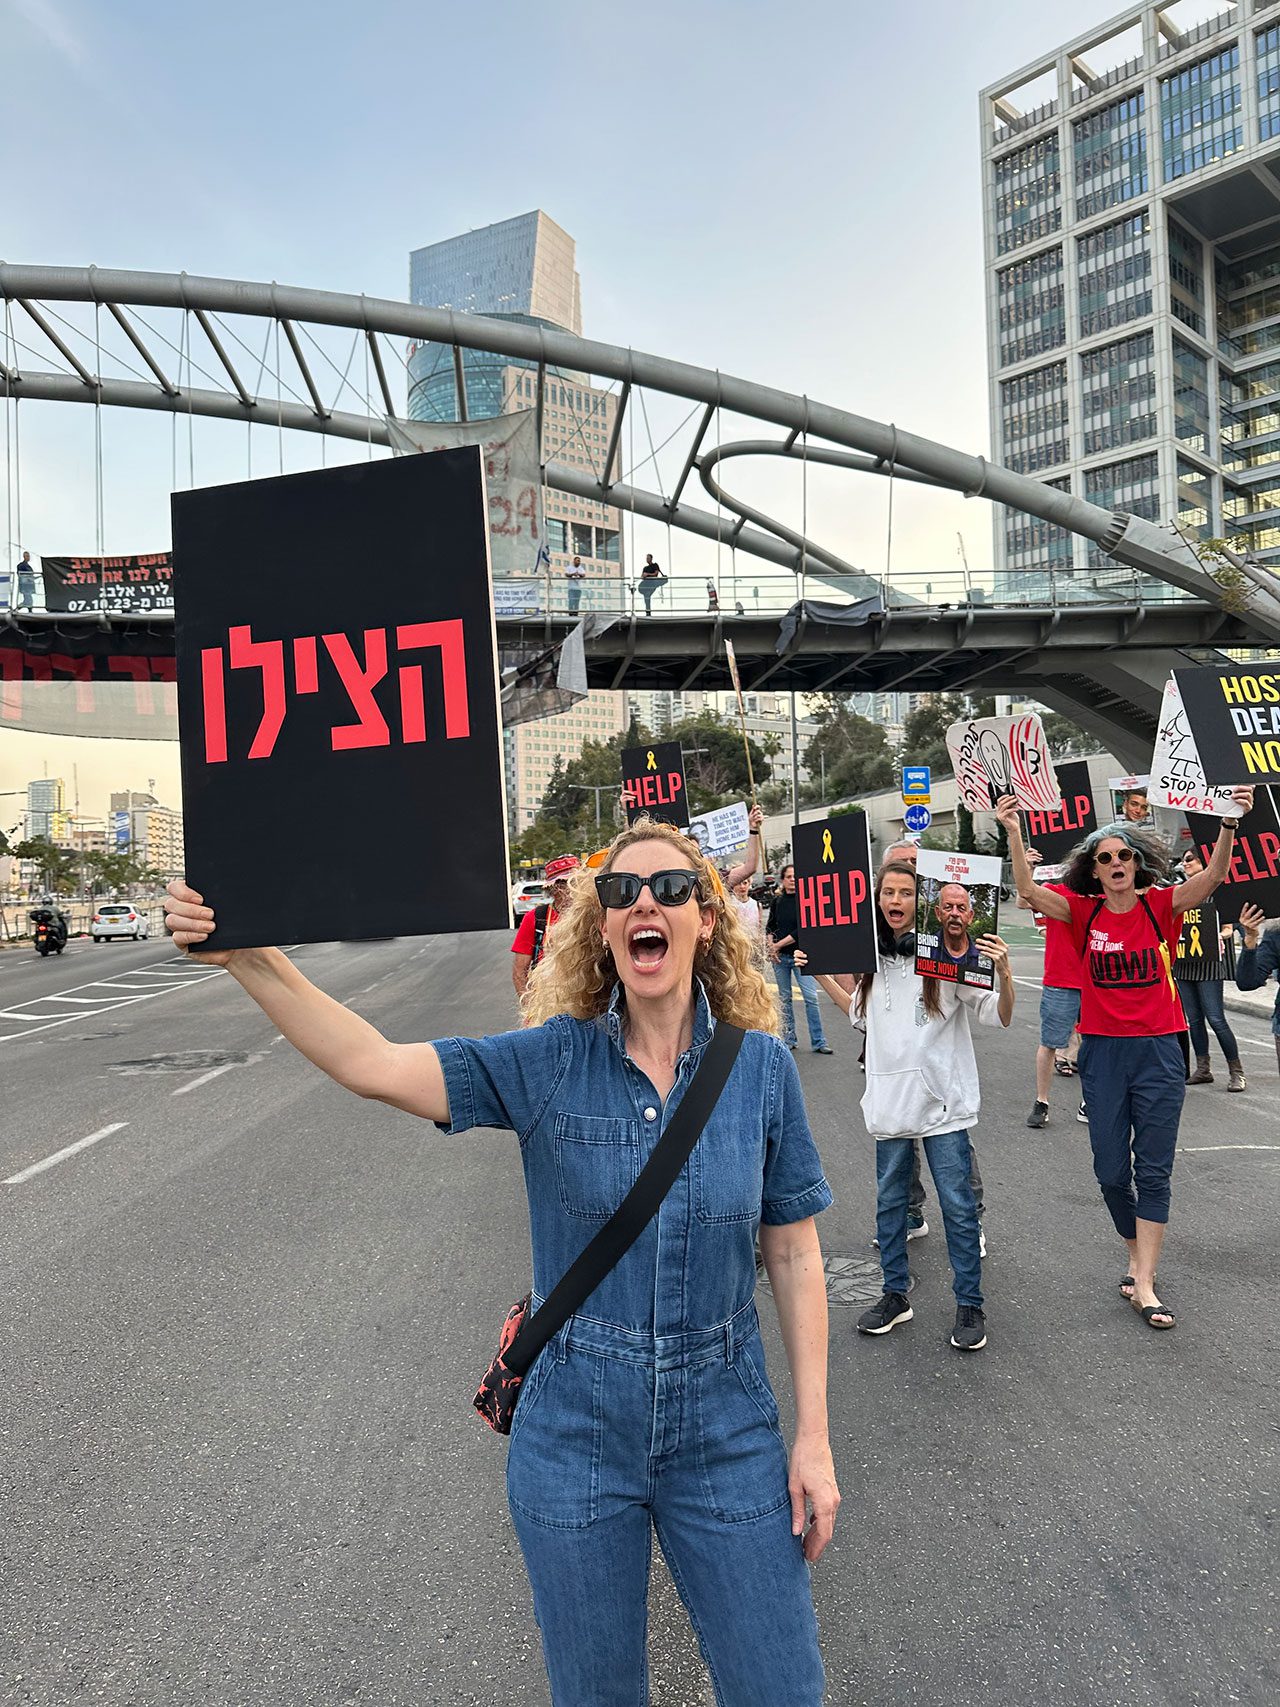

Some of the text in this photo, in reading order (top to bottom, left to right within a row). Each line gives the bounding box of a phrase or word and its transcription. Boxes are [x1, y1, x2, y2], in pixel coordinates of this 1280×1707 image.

[201, 618, 471, 764] הצילו
[1219, 674, 1280, 704] HOS
[626, 772, 682, 809] HELP
[1160, 775, 1196, 794] STOP
[1028, 795, 1091, 836] HELP
[798, 869, 866, 929] HELP
[917, 932, 939, 948] BRING
[917, 944, 931, 959] HIM
[1104, 940, 1125, 952] HOME
[917, 958, 937, 973] HOME
[937, 961, 959, 977] NOW!
[1089, 947, 1158, 981] NOW!
